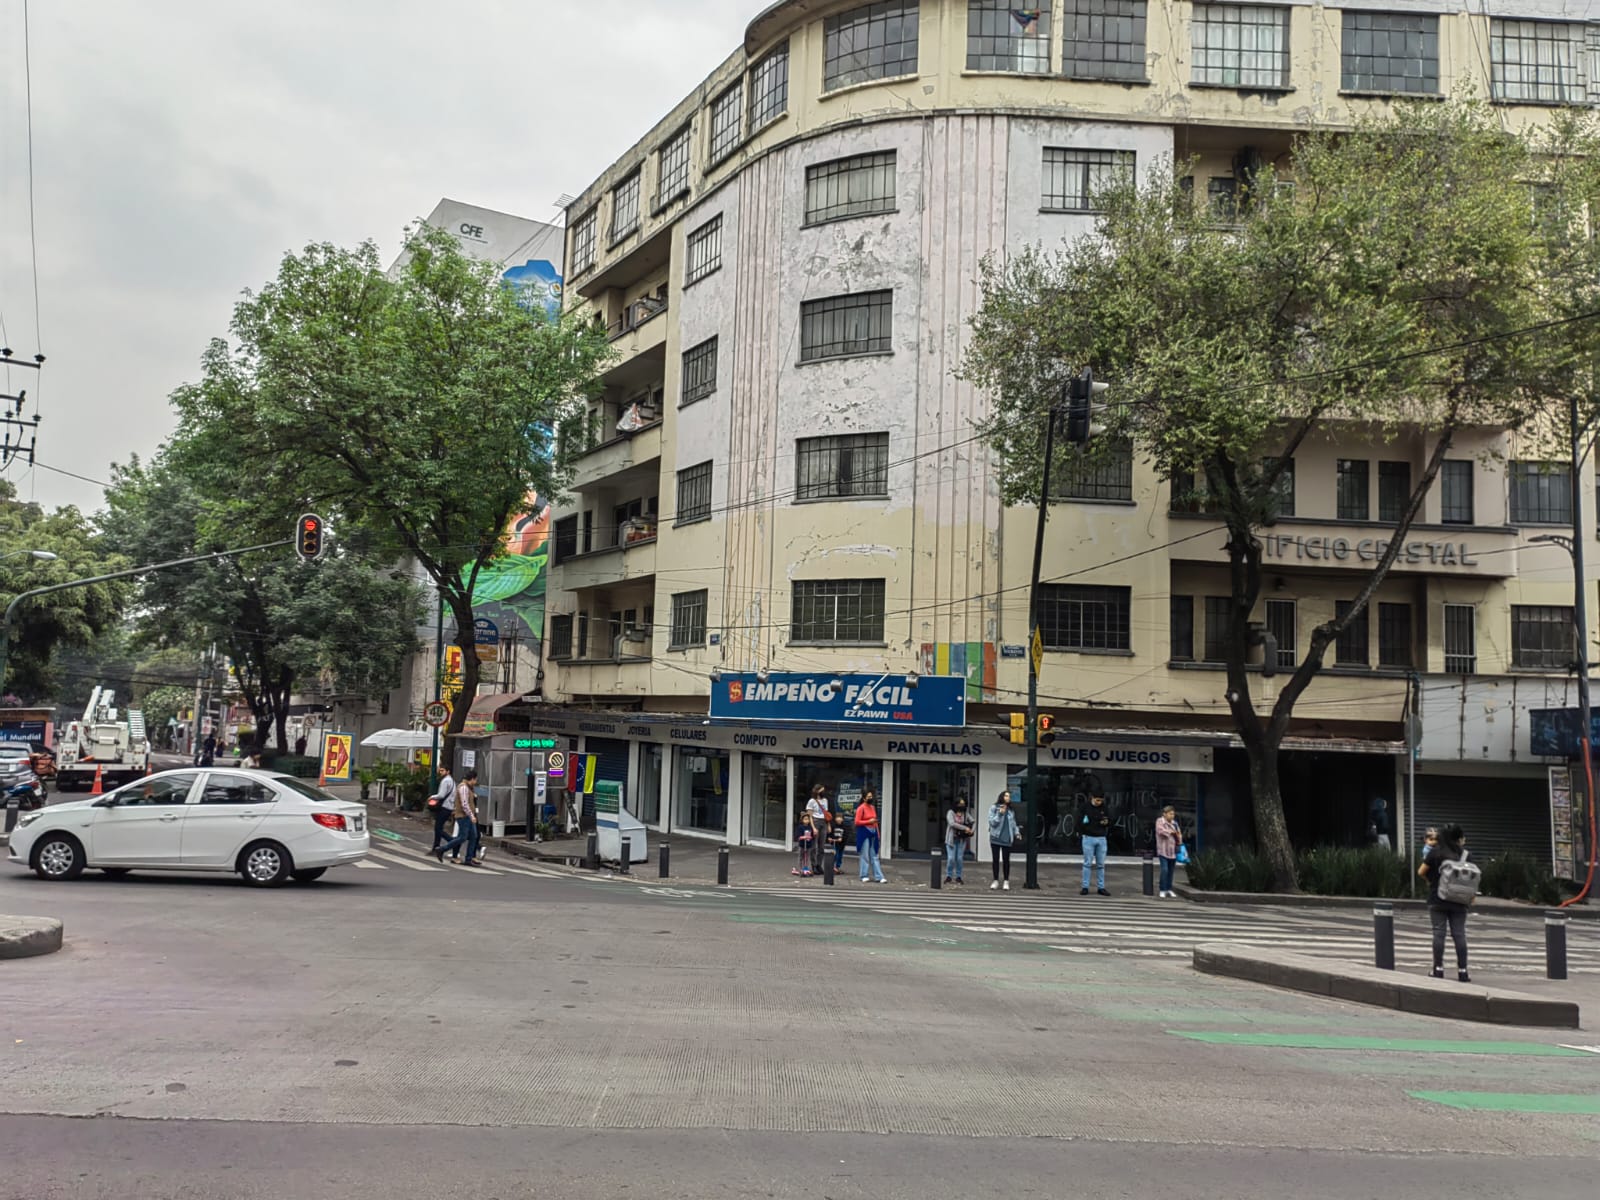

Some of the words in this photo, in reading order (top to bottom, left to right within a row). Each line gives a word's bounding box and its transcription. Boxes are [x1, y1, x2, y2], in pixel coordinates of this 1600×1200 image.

[460, 223, 483, 238] CFE
[744, 679, 834, 702] EMPEÑO
[844, 680, 913, 706] FÁCIL
[429, 705, 444, 717] 40
[892, 711, 914, 720] USA
[10, 733, 41, 741] Mundial
[627, 726, 651, 737] JOYERIA
[670, 729, 707, 741] CELULARES
[734, 733, 777, 746] COMPUTO
[802, 737, 864, 751] JOYERIA
[887, 740, 982, 756] PANTALLAS
[1051, 747, 1100, 761] VIDEO
[1105, 750, 1171, 764] JUEGOS
